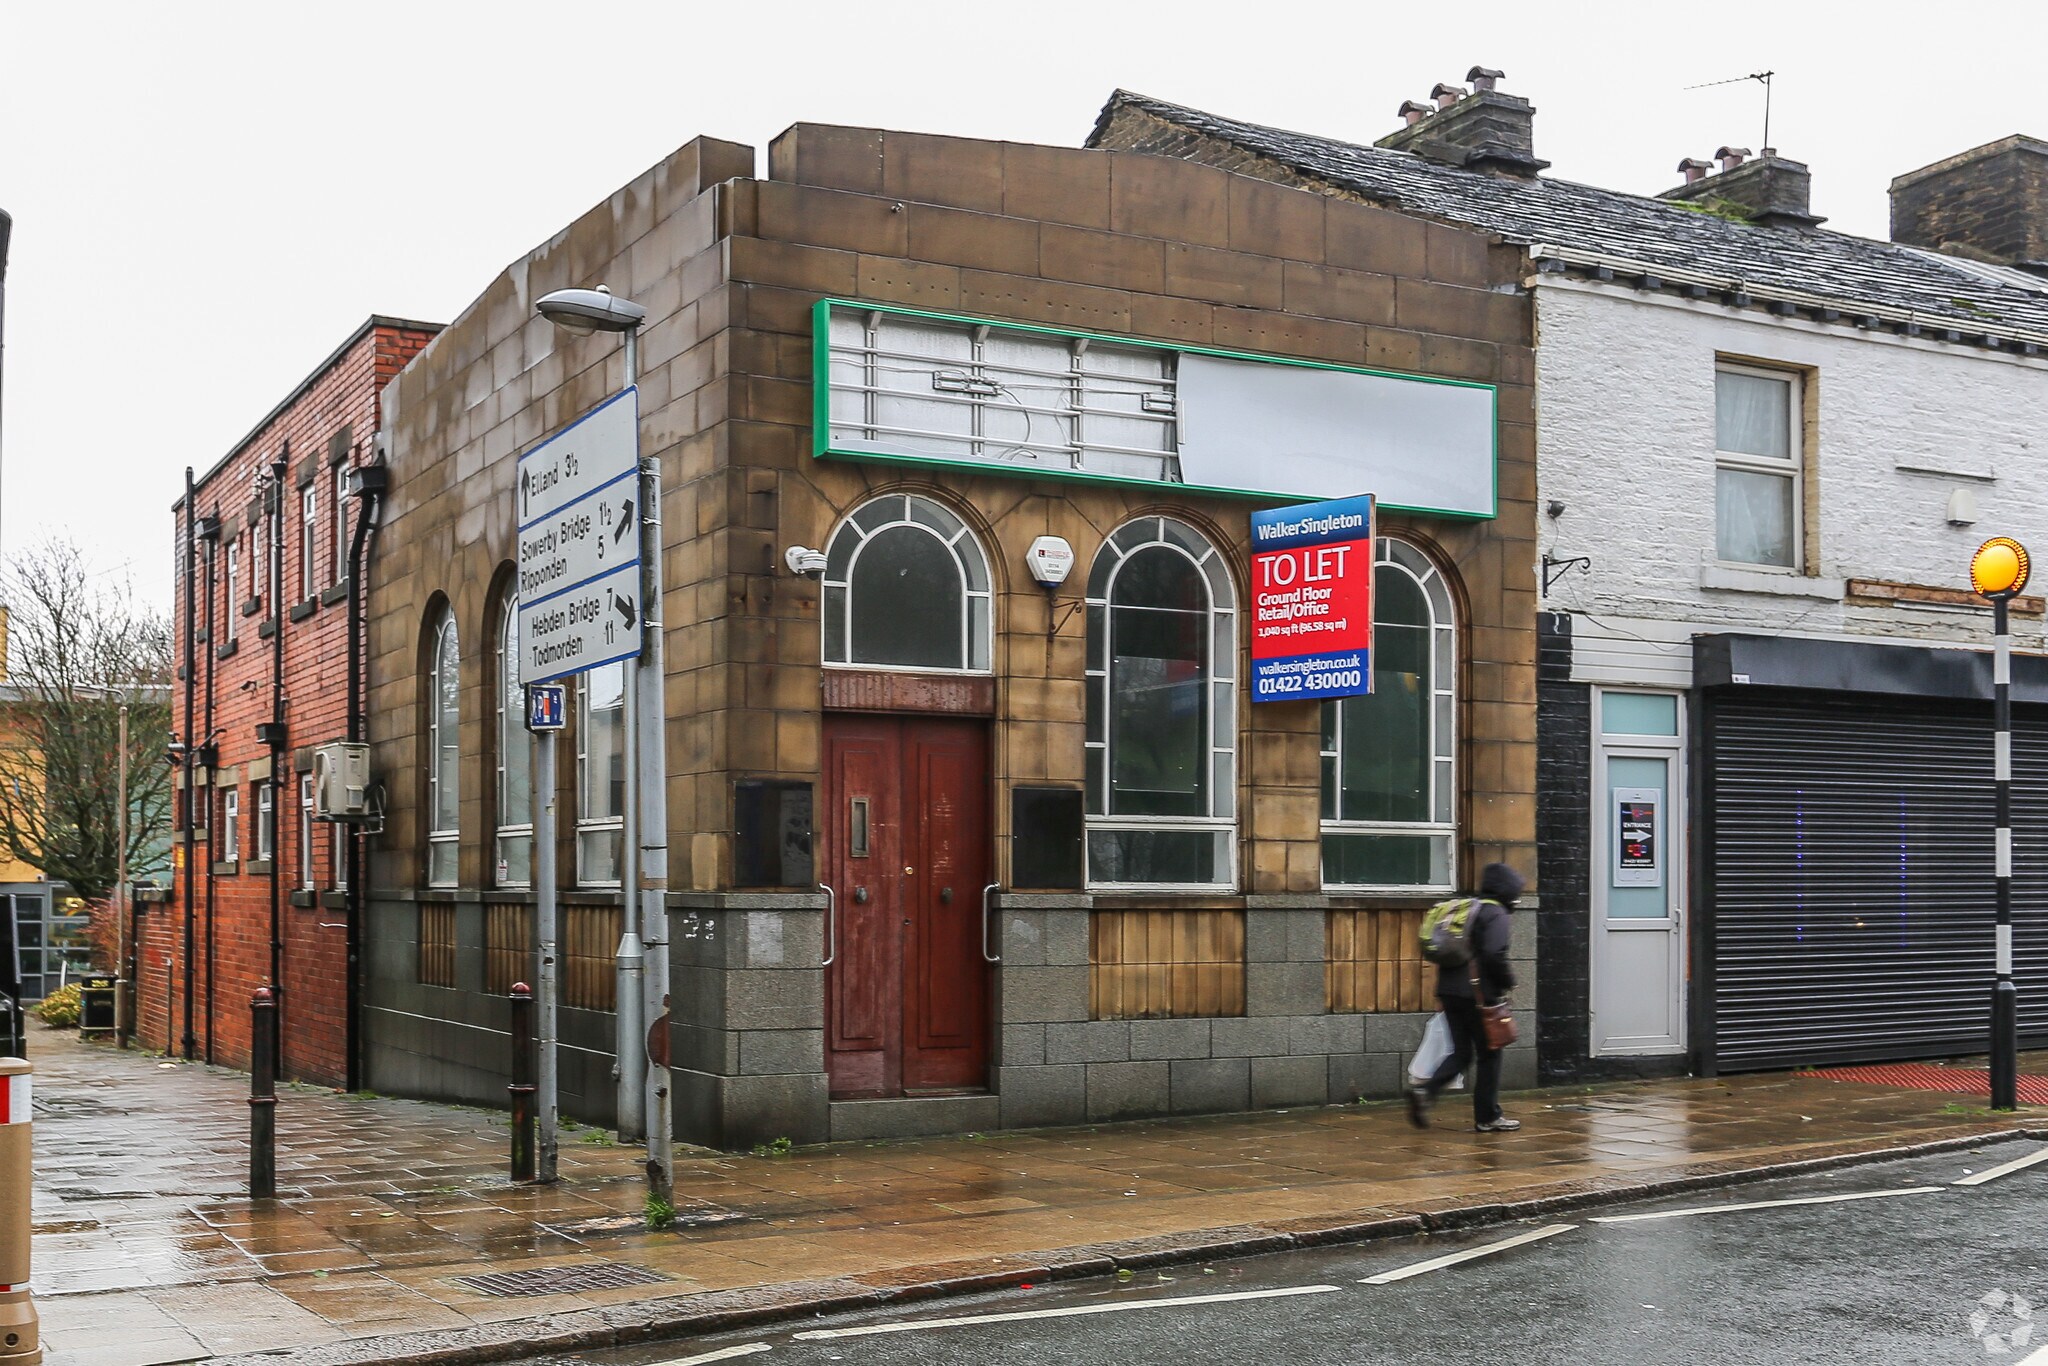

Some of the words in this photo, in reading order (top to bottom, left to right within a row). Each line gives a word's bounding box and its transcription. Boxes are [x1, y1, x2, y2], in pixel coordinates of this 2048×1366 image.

[531, 461, 559, 497] Elland
[521, 529, 558, 563] Sowerby
[561, 514, 591, 544] Bridge
[521, 556, 567, 595] Ripponden
[597, 534, 605, 560] 5
[1257, 553, 1297, 587] TO
[1303, 545, 1352, 583] LET
[532, 609, 566, 639] Hebden
[569, 596, 600, 625] Bridge
[606, 587, 613, 612] 7
[1257, 587, 1301, 607] Ground
[1302, 586, 1332, 602] Floor
[1258, 601, 1329, 621] Retail/Office
[532, 634, 583, 668] Todmorden
[605, 620, 614, 645] 11
[1281, 626, 1290, 637] sq
[1291, 623, 1299, 634] ft
[1324, 621, 1334, 632] sq
[1334, 617, 1347, 631] m)
[1258, 653, 1361, 676] walkersingleton.co.uk
[1258, 675, 1303, 694] 01422
[1304, 670, 1361, 690] 430000
